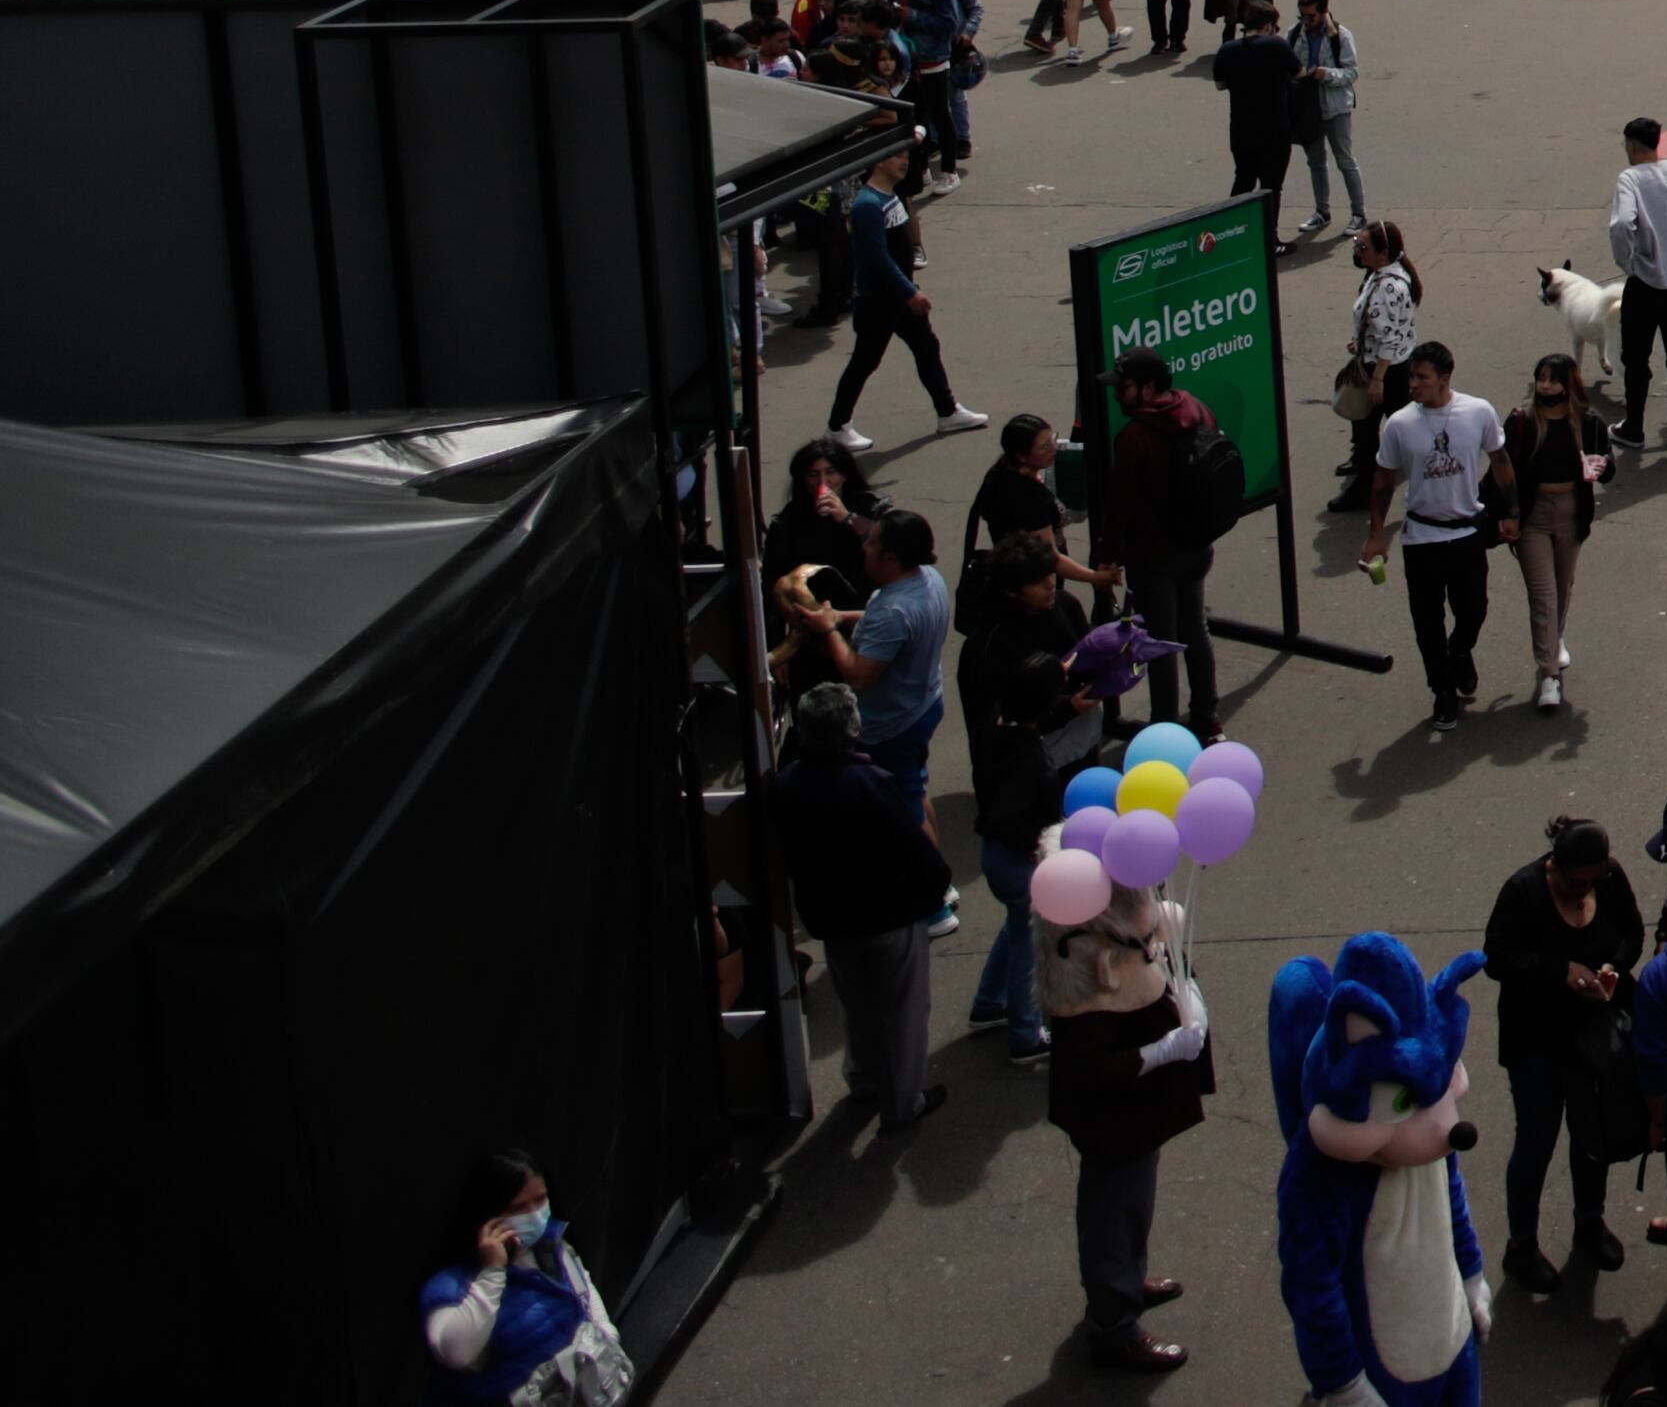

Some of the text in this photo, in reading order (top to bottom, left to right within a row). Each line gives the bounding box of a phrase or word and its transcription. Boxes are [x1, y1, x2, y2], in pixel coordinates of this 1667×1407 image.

[1151, 254, 1177, 270] oficial
[1111, 287, 1258, 361] Maletero
[1190, 333, 1254, 371] gratuito
